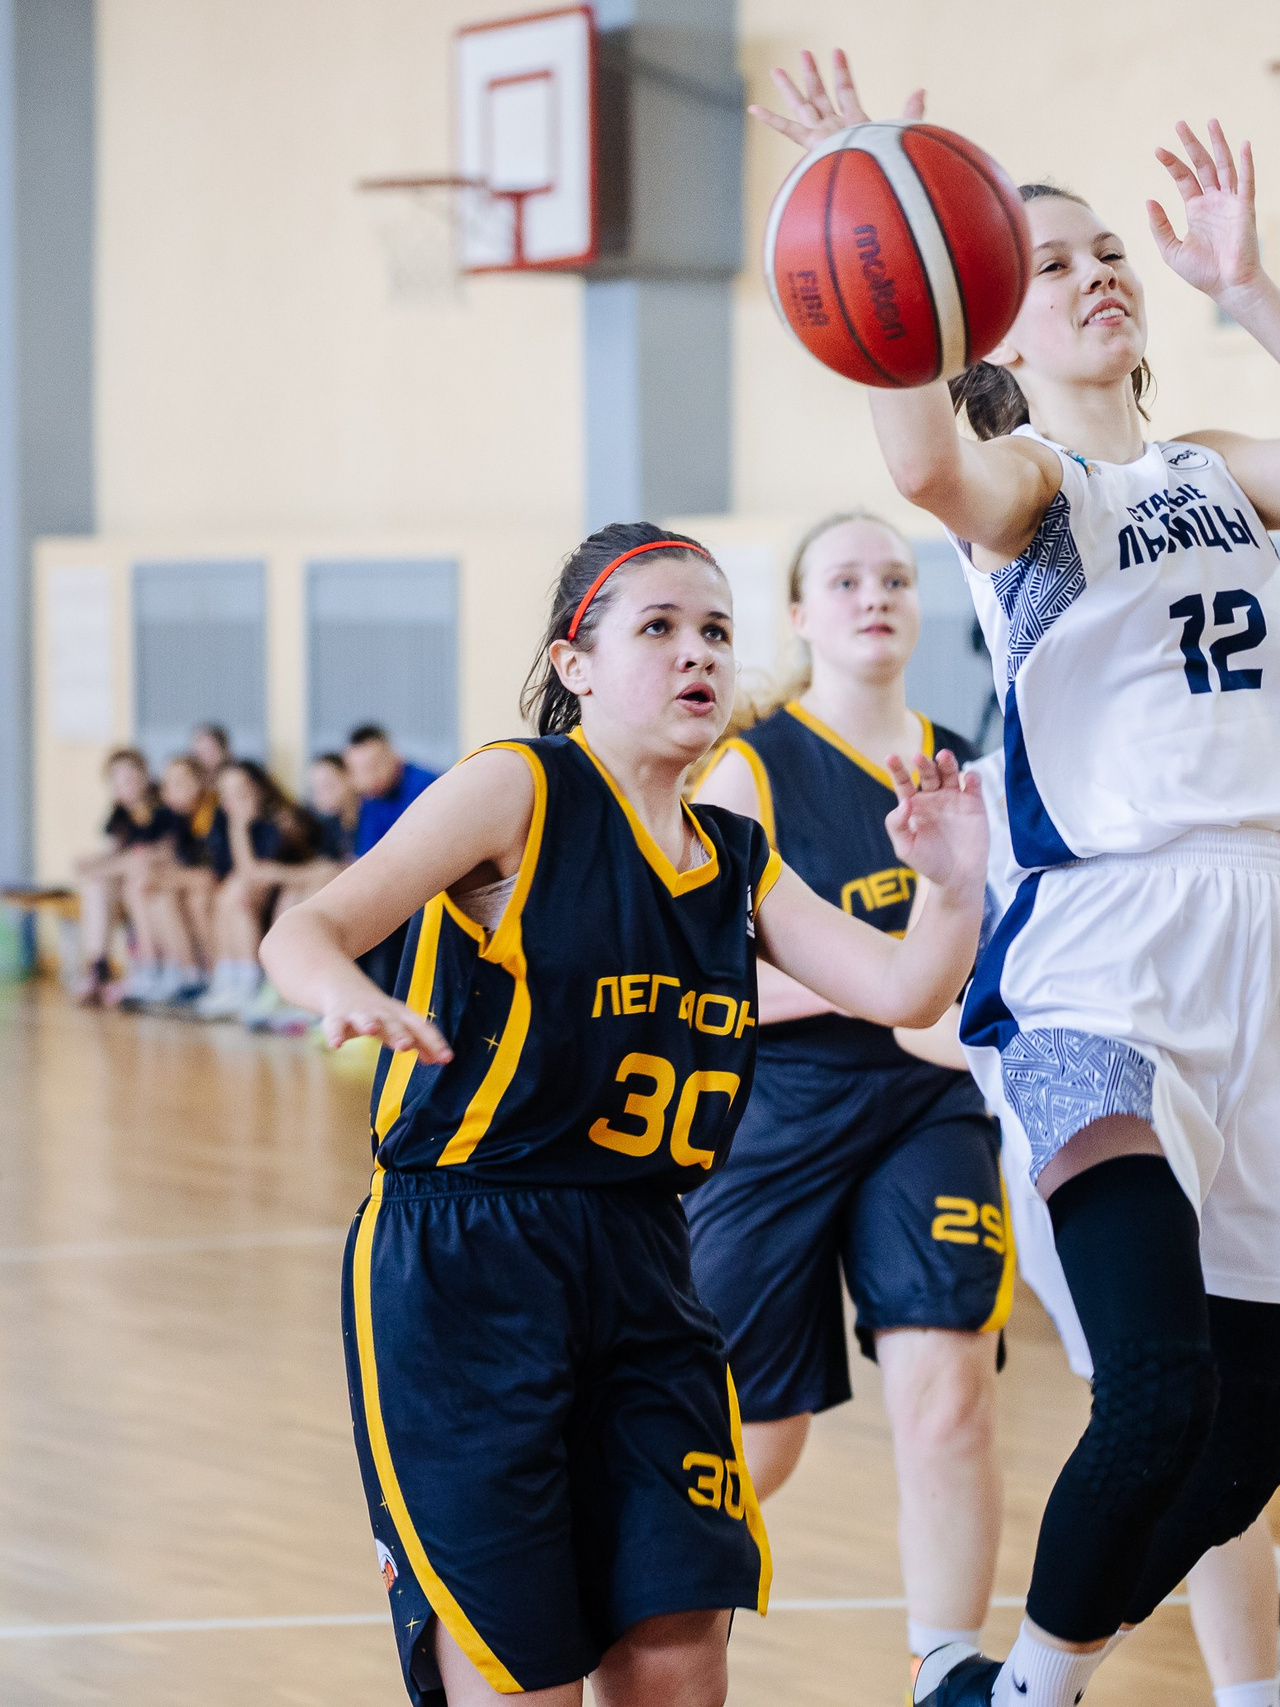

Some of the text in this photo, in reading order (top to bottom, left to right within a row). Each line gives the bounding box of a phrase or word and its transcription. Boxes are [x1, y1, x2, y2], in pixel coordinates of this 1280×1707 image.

[854, 224, 907, 341] molten
[1169, 588, 1268, 694] 12
[588, 1052, 741, 1171] 30
[682, 1450, 746, 1521] 30
